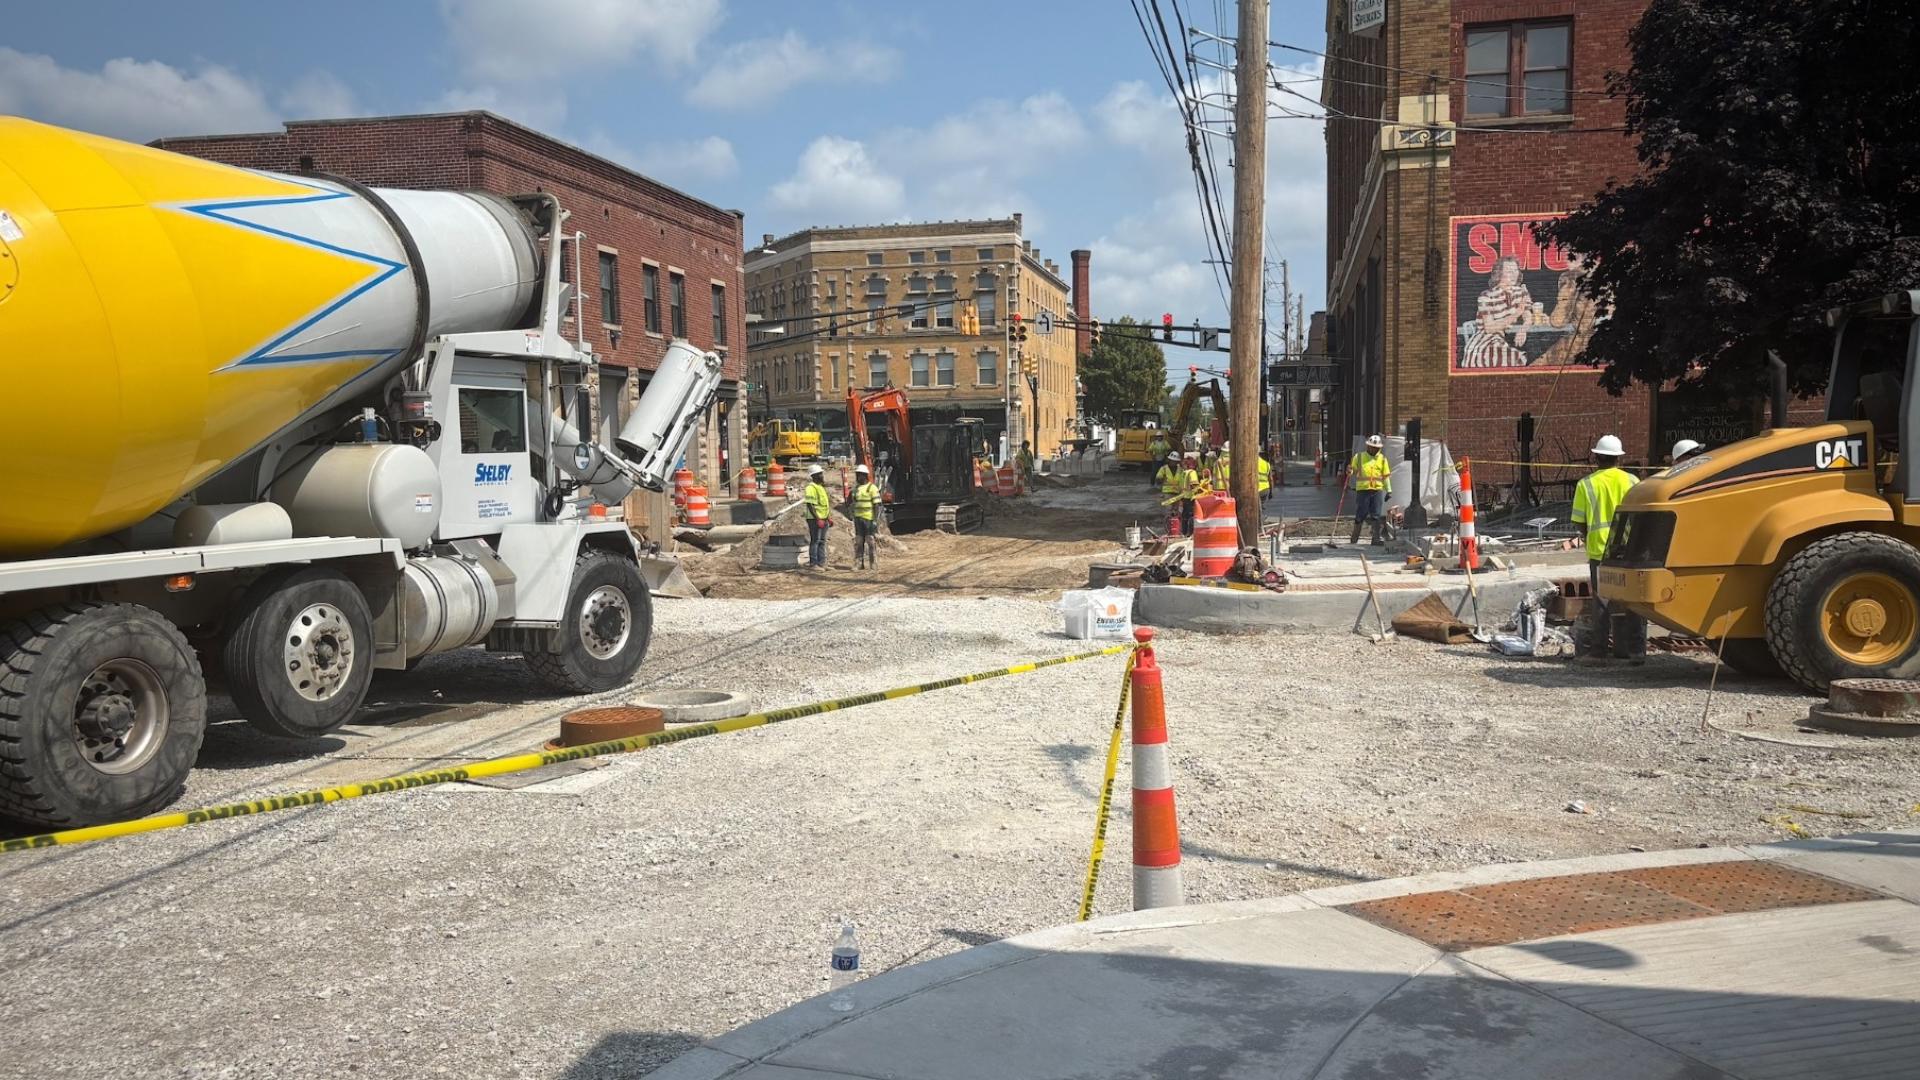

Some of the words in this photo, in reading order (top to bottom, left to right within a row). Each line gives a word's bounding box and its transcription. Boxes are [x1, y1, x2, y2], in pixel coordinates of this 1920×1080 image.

[1296, 366, 1330, 384] BAR
[1815, 440, 1863, 469] CAT
[474, 462, 512, 482] SHELBY
